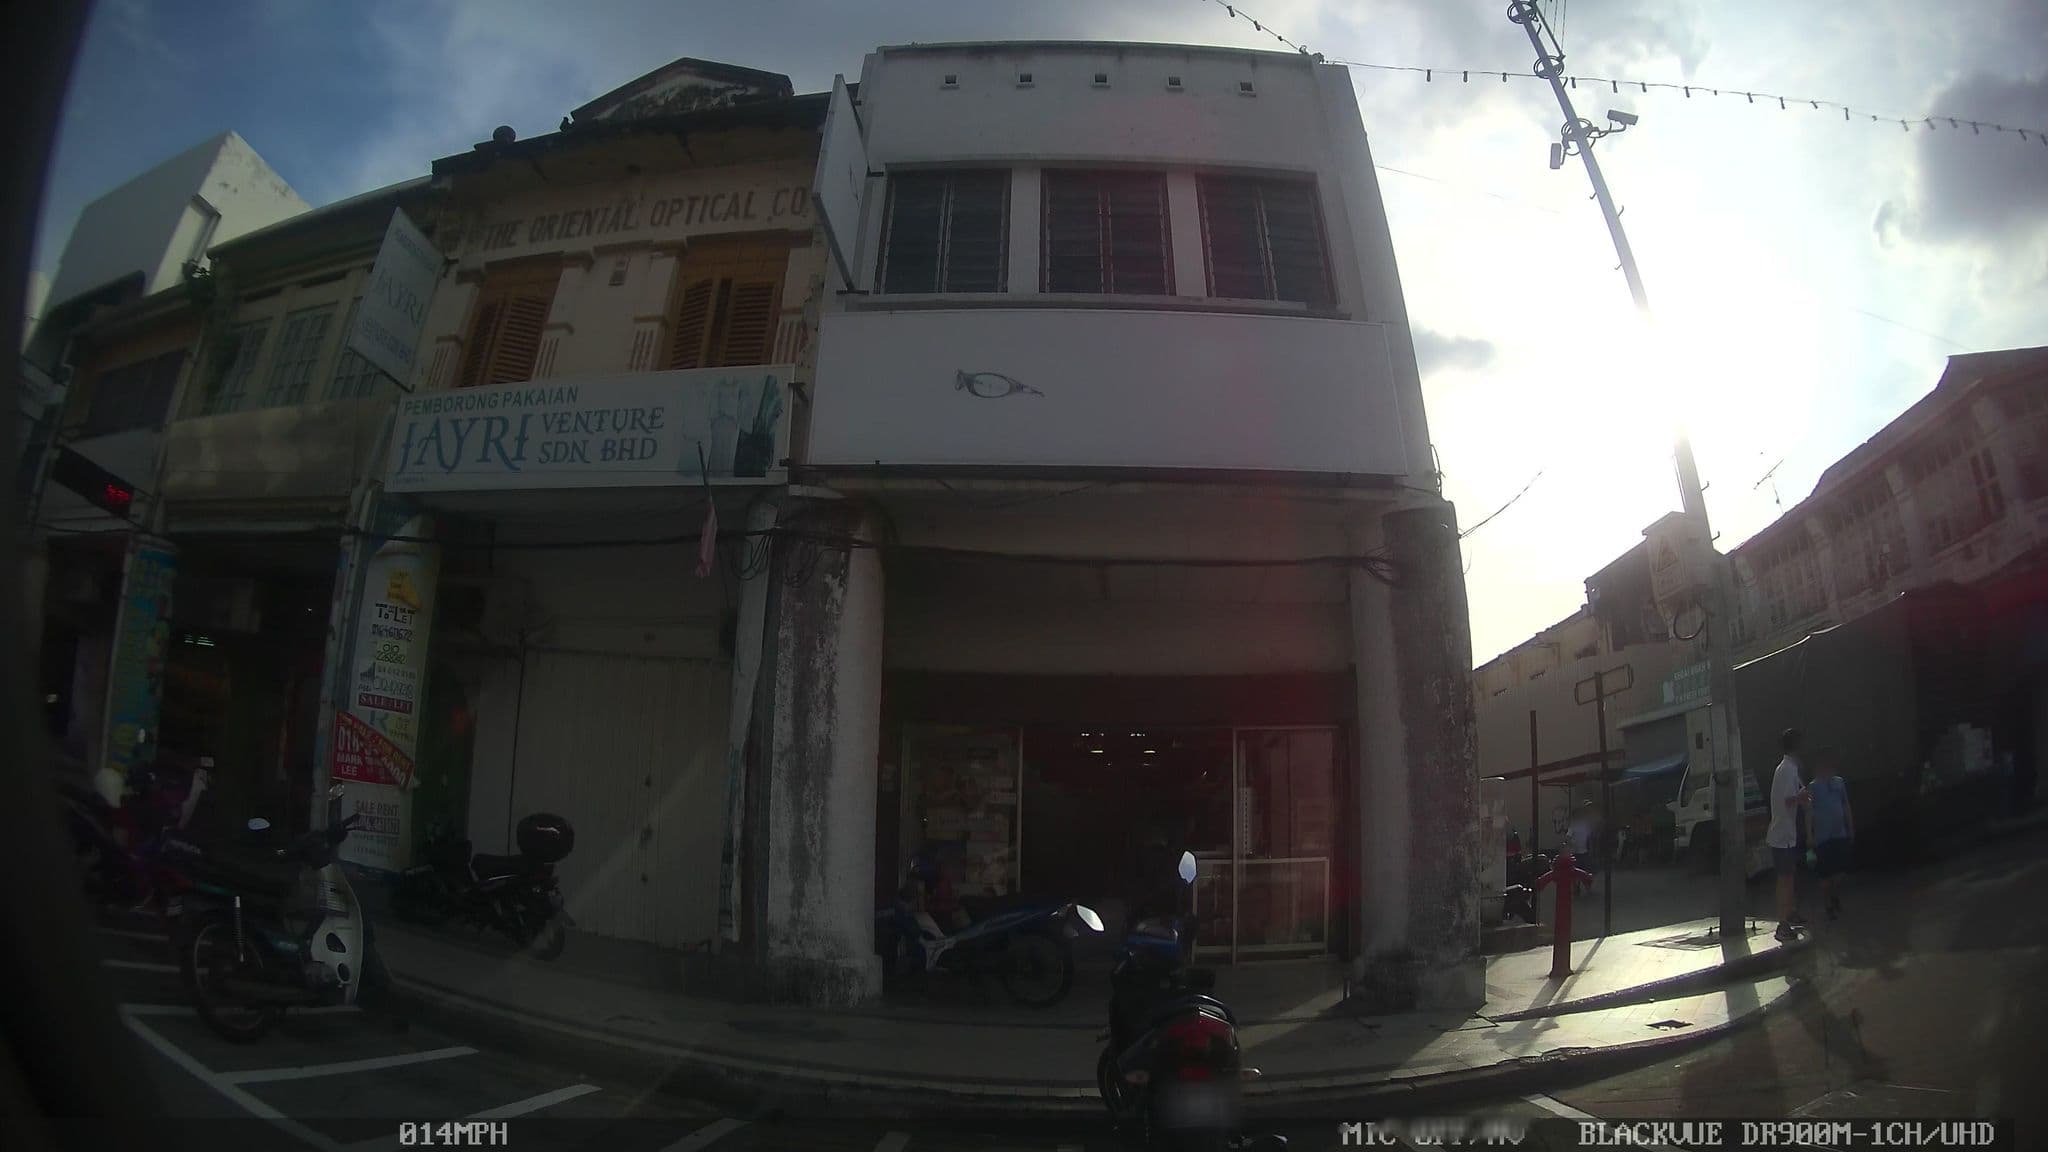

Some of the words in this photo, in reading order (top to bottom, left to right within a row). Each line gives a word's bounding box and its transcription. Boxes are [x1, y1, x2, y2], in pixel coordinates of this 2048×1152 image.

[484, 220, 523, 249] THE
[528, 200, 640, 244] ORIENTAL
[651, 190, 756, 227] OPTICAL
[404, 394, 499, 416] PEMBORONG
[502, 386, 579, 408] PAKAIAN
[542, 406, 665, 434] VENTURE
[400, 411, 534, 475] JAYRI
[538, 440, 592, 465] SDN
[599, 437, 658, 462] BHD
